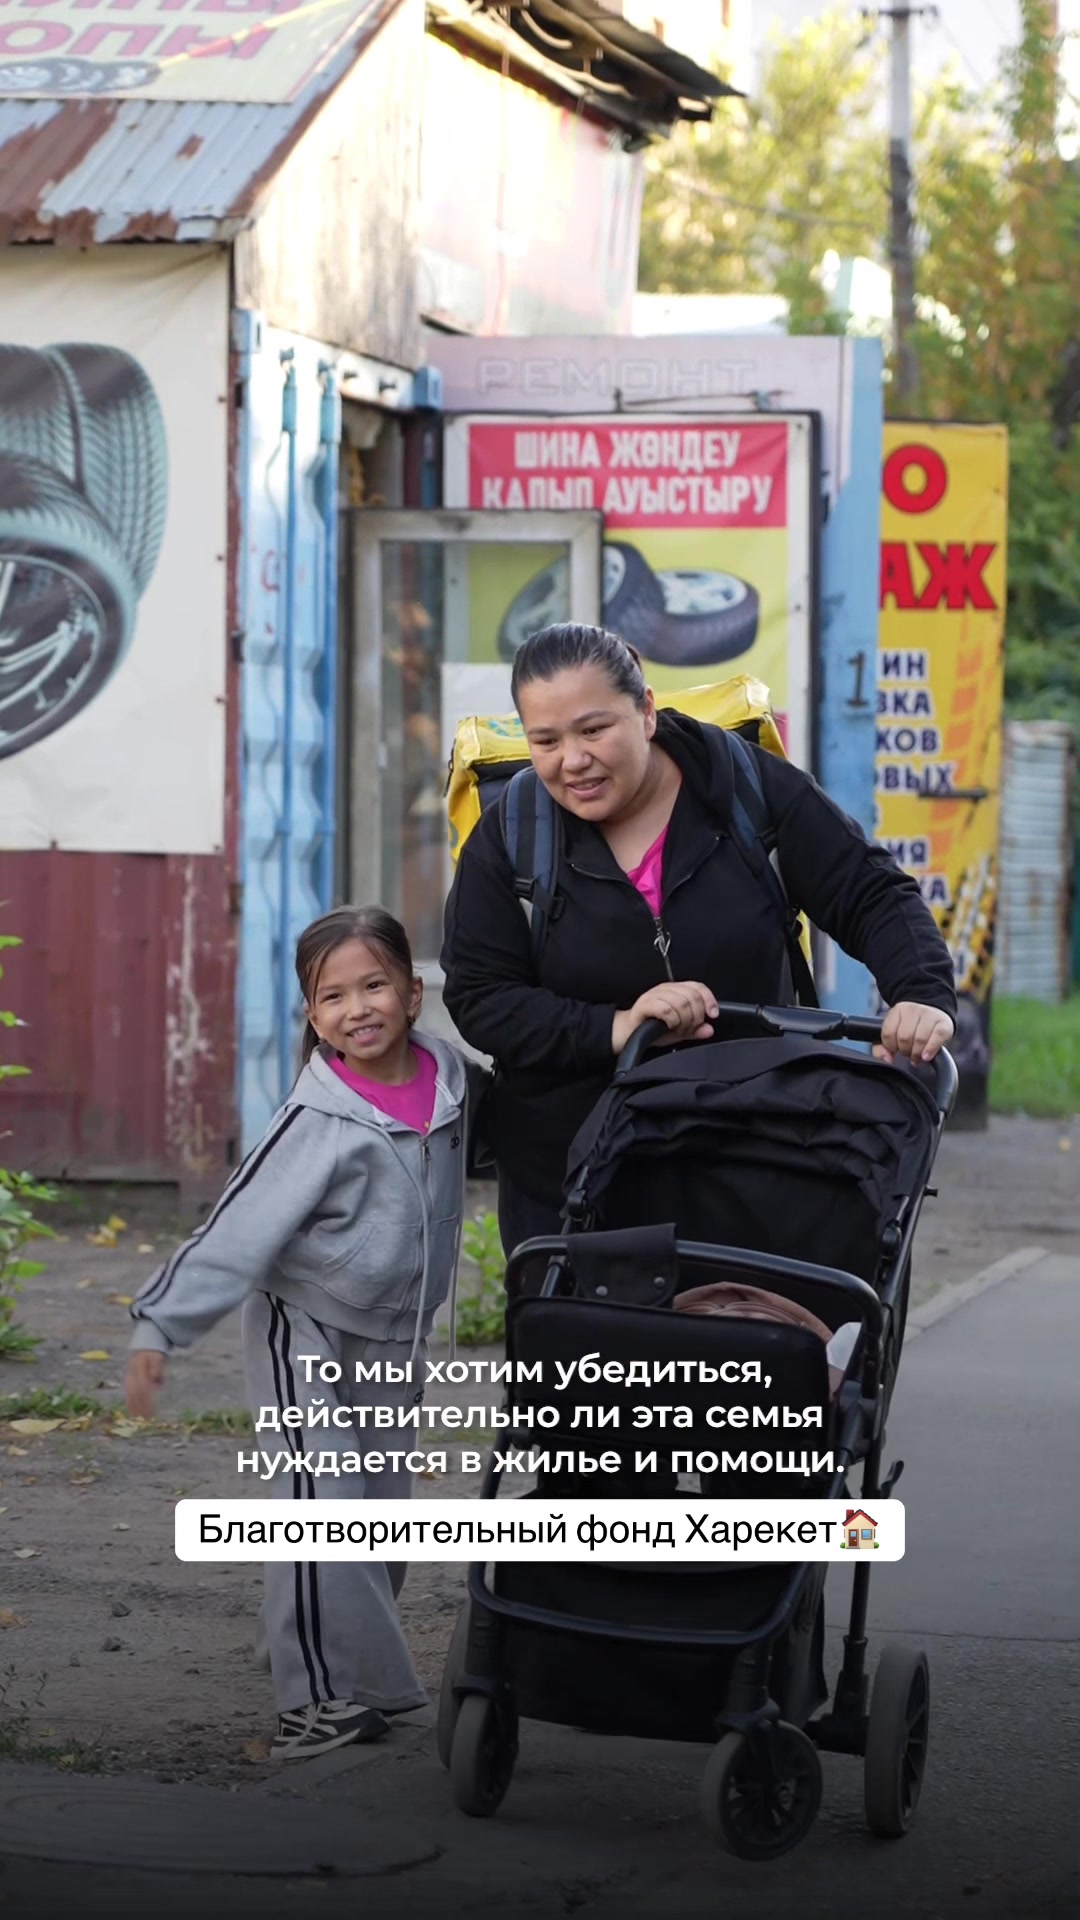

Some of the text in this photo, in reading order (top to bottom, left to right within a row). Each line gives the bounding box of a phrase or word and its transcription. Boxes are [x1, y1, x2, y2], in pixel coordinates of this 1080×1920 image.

[475, 357, 757, 396] РЕМОНТ
[514, 430, 600, 469] ШИНА
[603, 475, 773, 515] АУЫСТЫРУ
